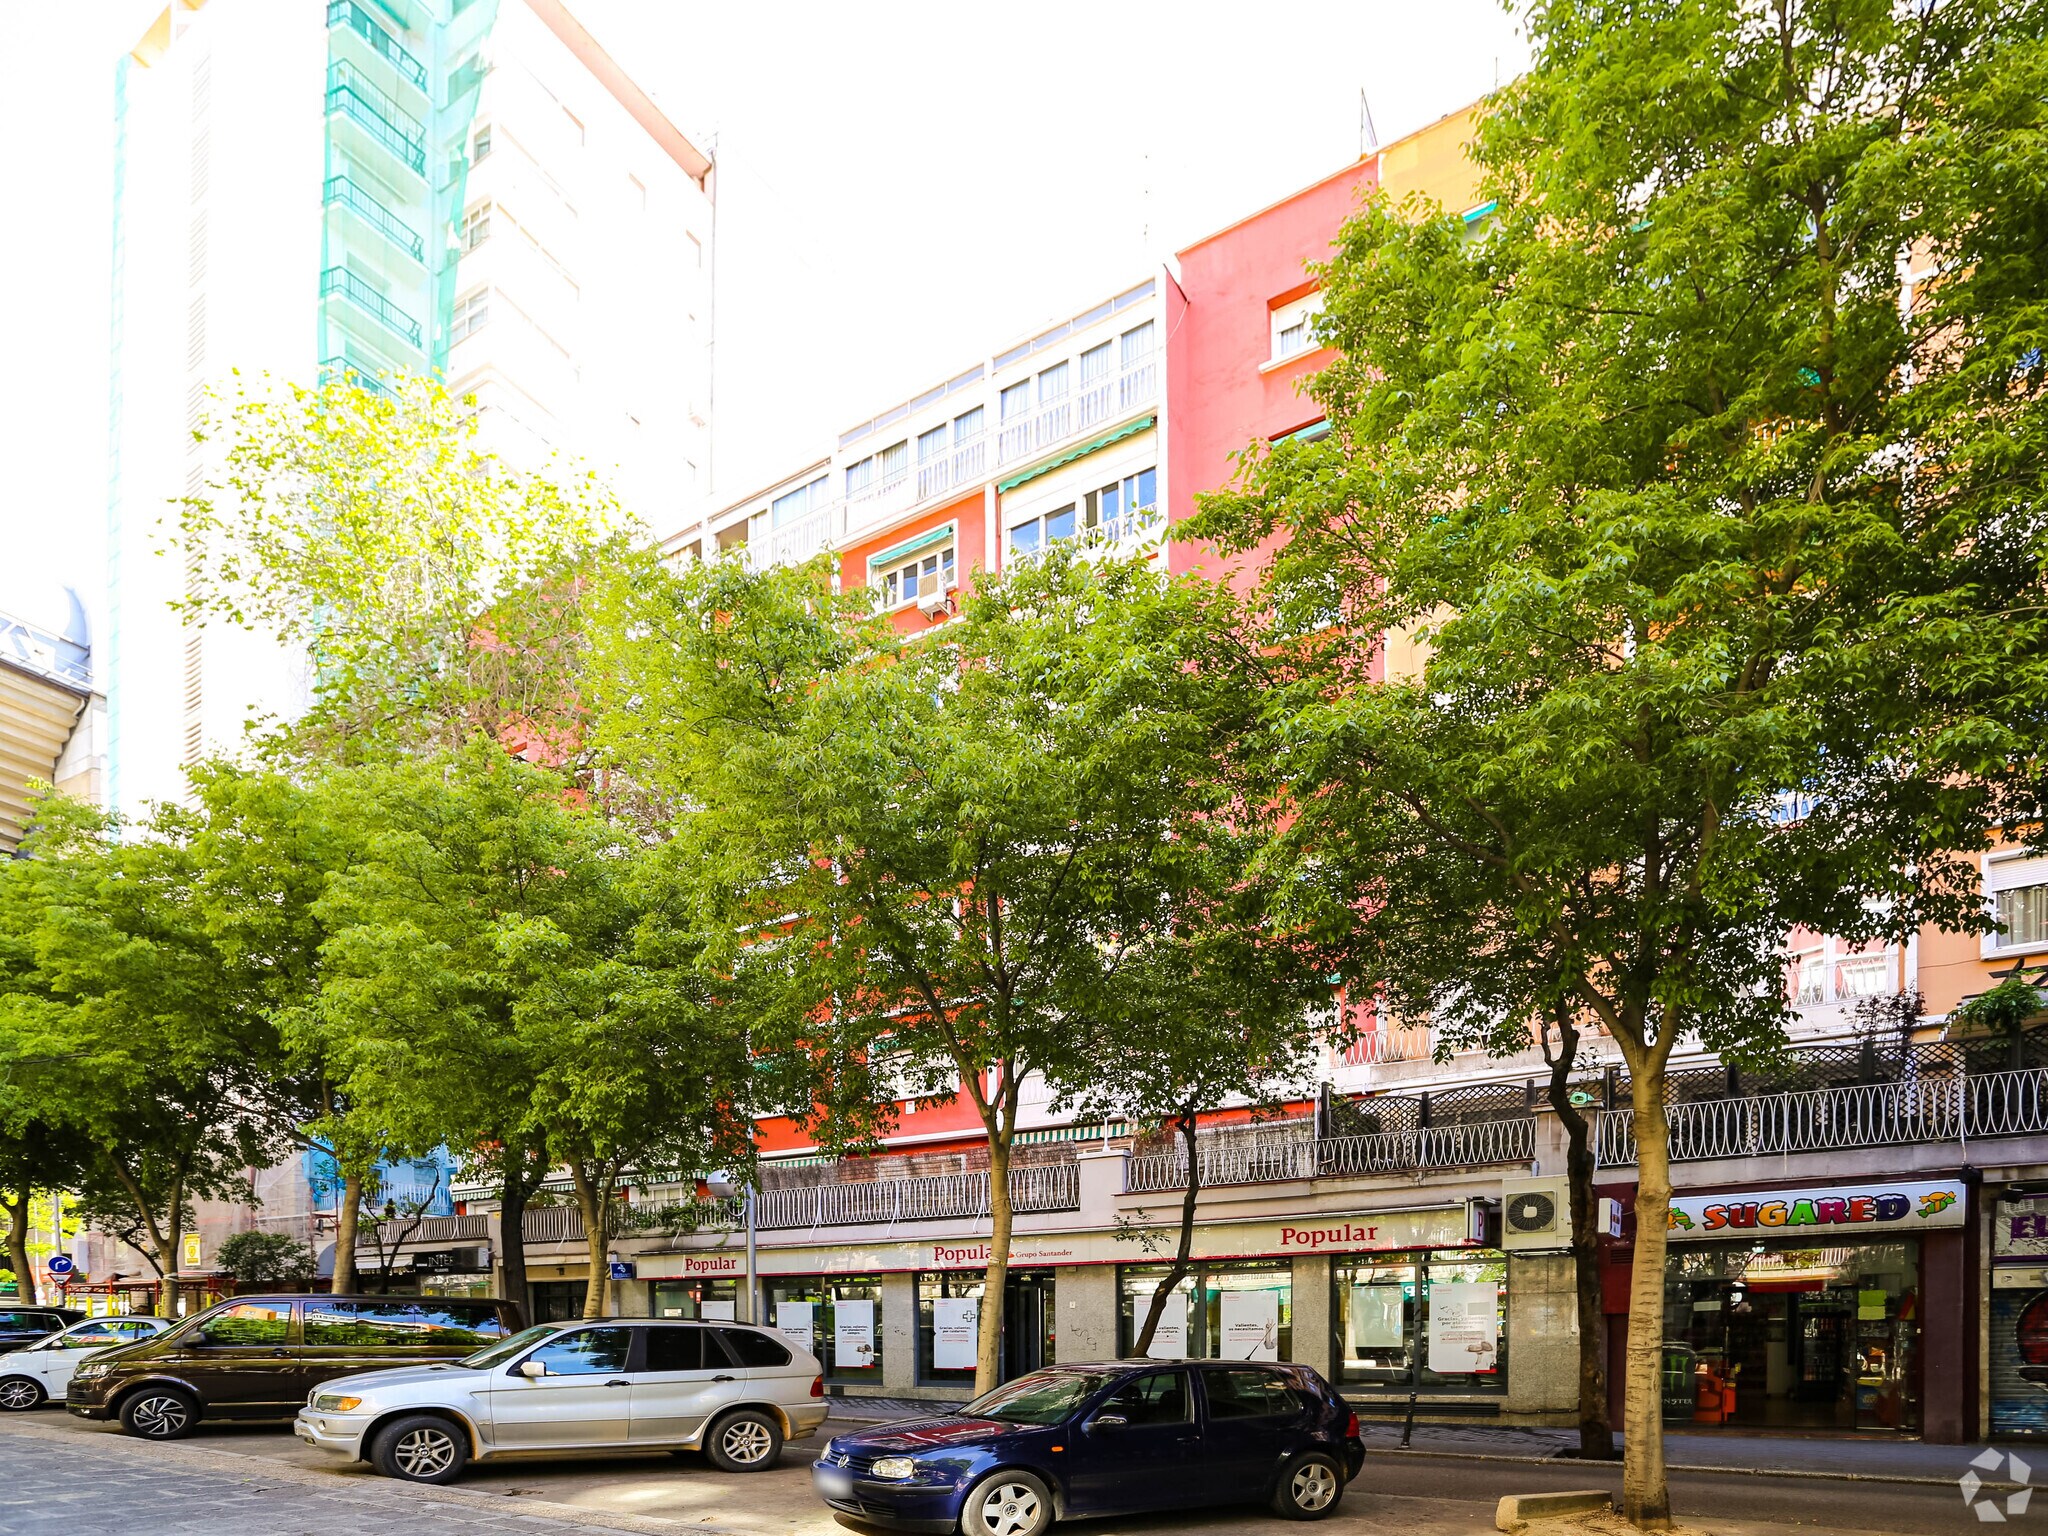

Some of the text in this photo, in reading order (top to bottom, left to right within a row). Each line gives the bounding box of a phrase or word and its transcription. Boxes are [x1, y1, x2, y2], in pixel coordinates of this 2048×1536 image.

[1702, 1193, 1911, 1231] SUGARED
[1477, 1211, 1484, 1237] P
[1281, 1224, 1378, 1248] Popular
[685, 1257, 736, 1273] Popular
[934, 1244, 992, 1264] Popula
[1015, 1249, 1073, 1259] Grupo Santander
